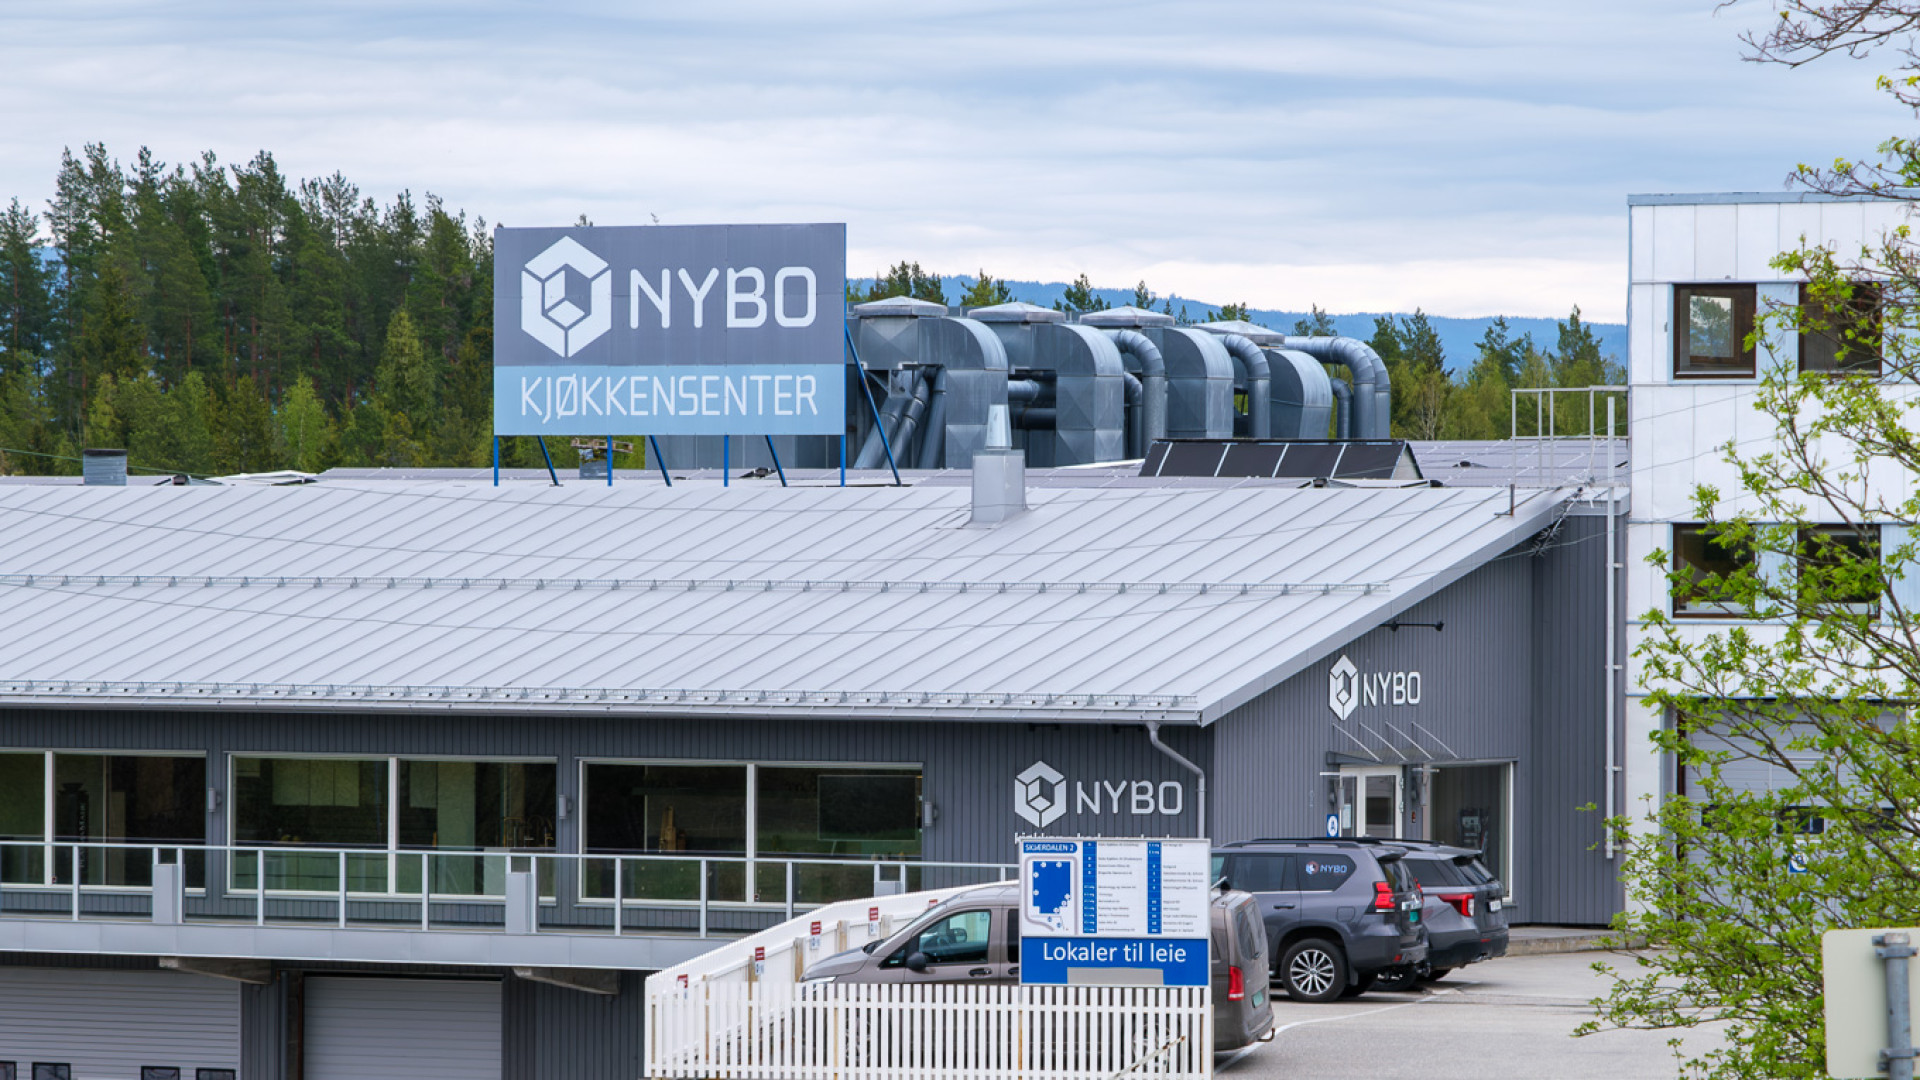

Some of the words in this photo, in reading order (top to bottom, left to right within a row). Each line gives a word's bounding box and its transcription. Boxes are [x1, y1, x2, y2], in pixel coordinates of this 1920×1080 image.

[630, 266, 817, 329] NYBO
[521, 373, 818, 424] KJØKKENSENTER
[1363, 671, 1421, 706] NYBO
[1076, 780, 1182, 815] NYBO
[1069, 843, 1074, 851] 2
[1320, 864, 1348, 874] NYBO
[1043, 941, 1118, 962] Lokaler
[1123, 943, 1143, 962] til
[1150, 943, 1187, 963] leie
